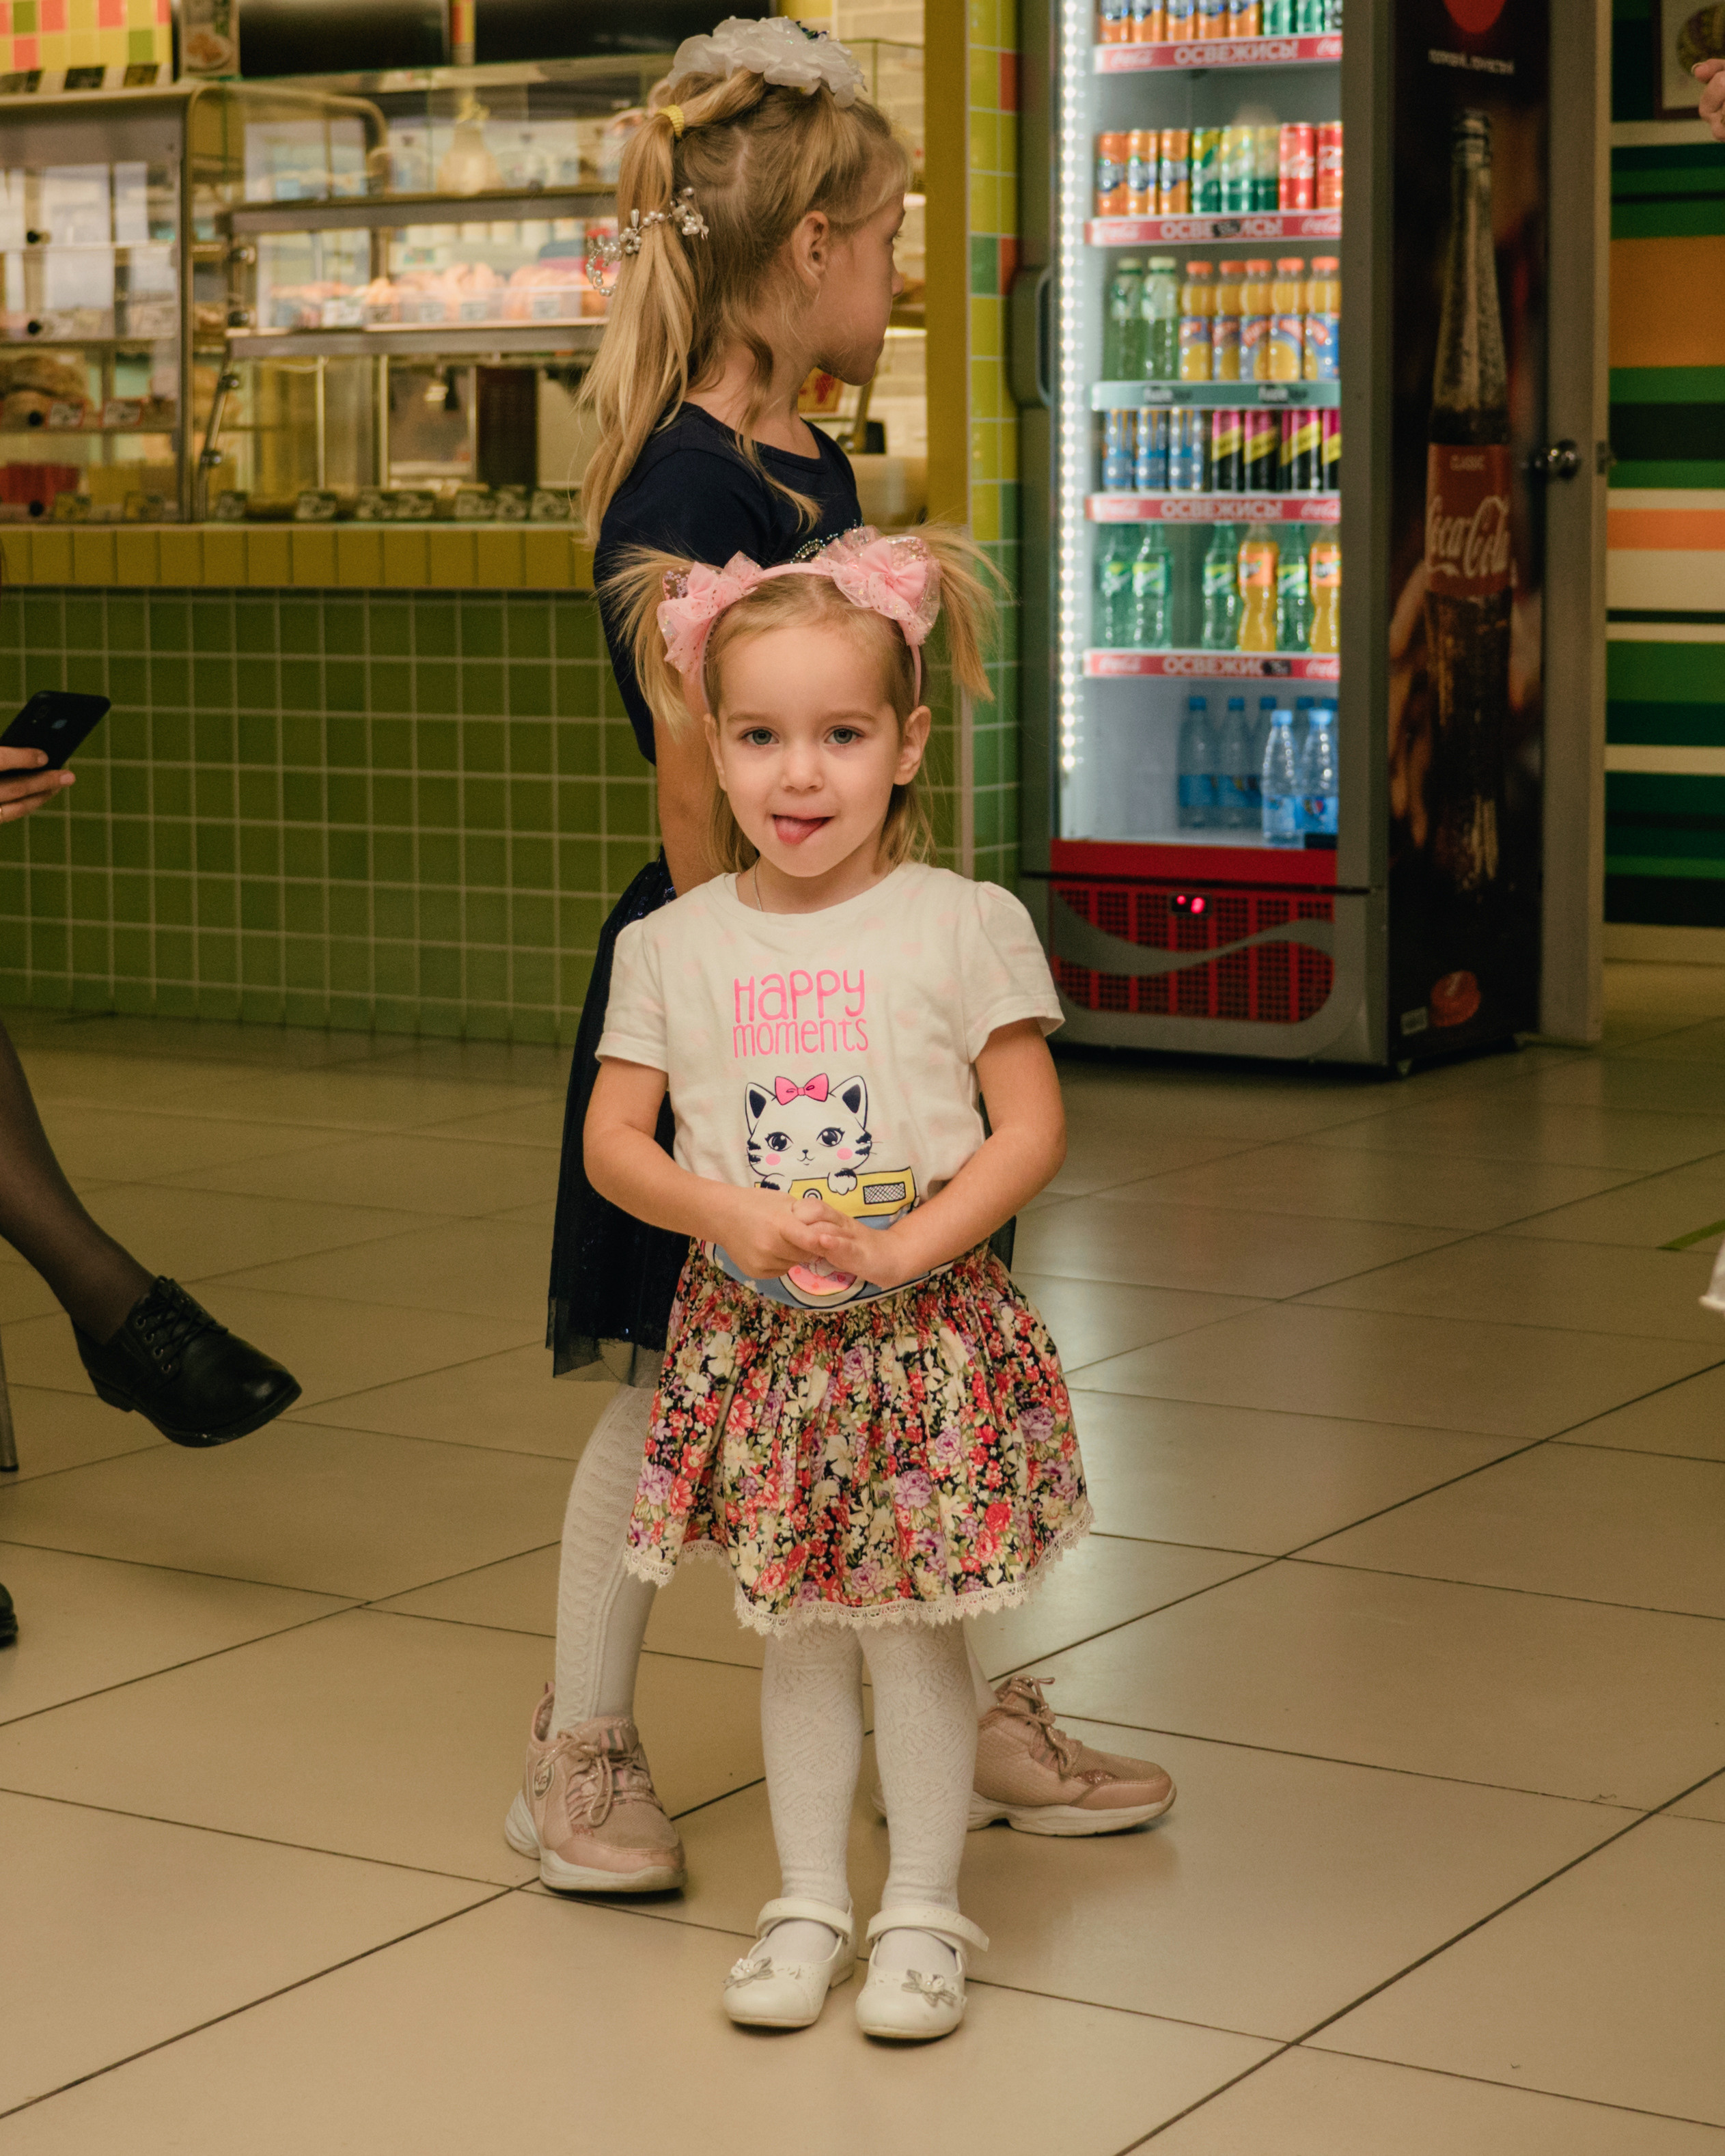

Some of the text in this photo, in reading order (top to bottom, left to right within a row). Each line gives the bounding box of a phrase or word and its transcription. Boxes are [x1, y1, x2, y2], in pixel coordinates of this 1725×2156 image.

[1174, 39, 1299, 65] ОСВЕЖИСЬ!
[734, 969, 865, 1023] Happy
[732, 1017, 869, 1058] moments
